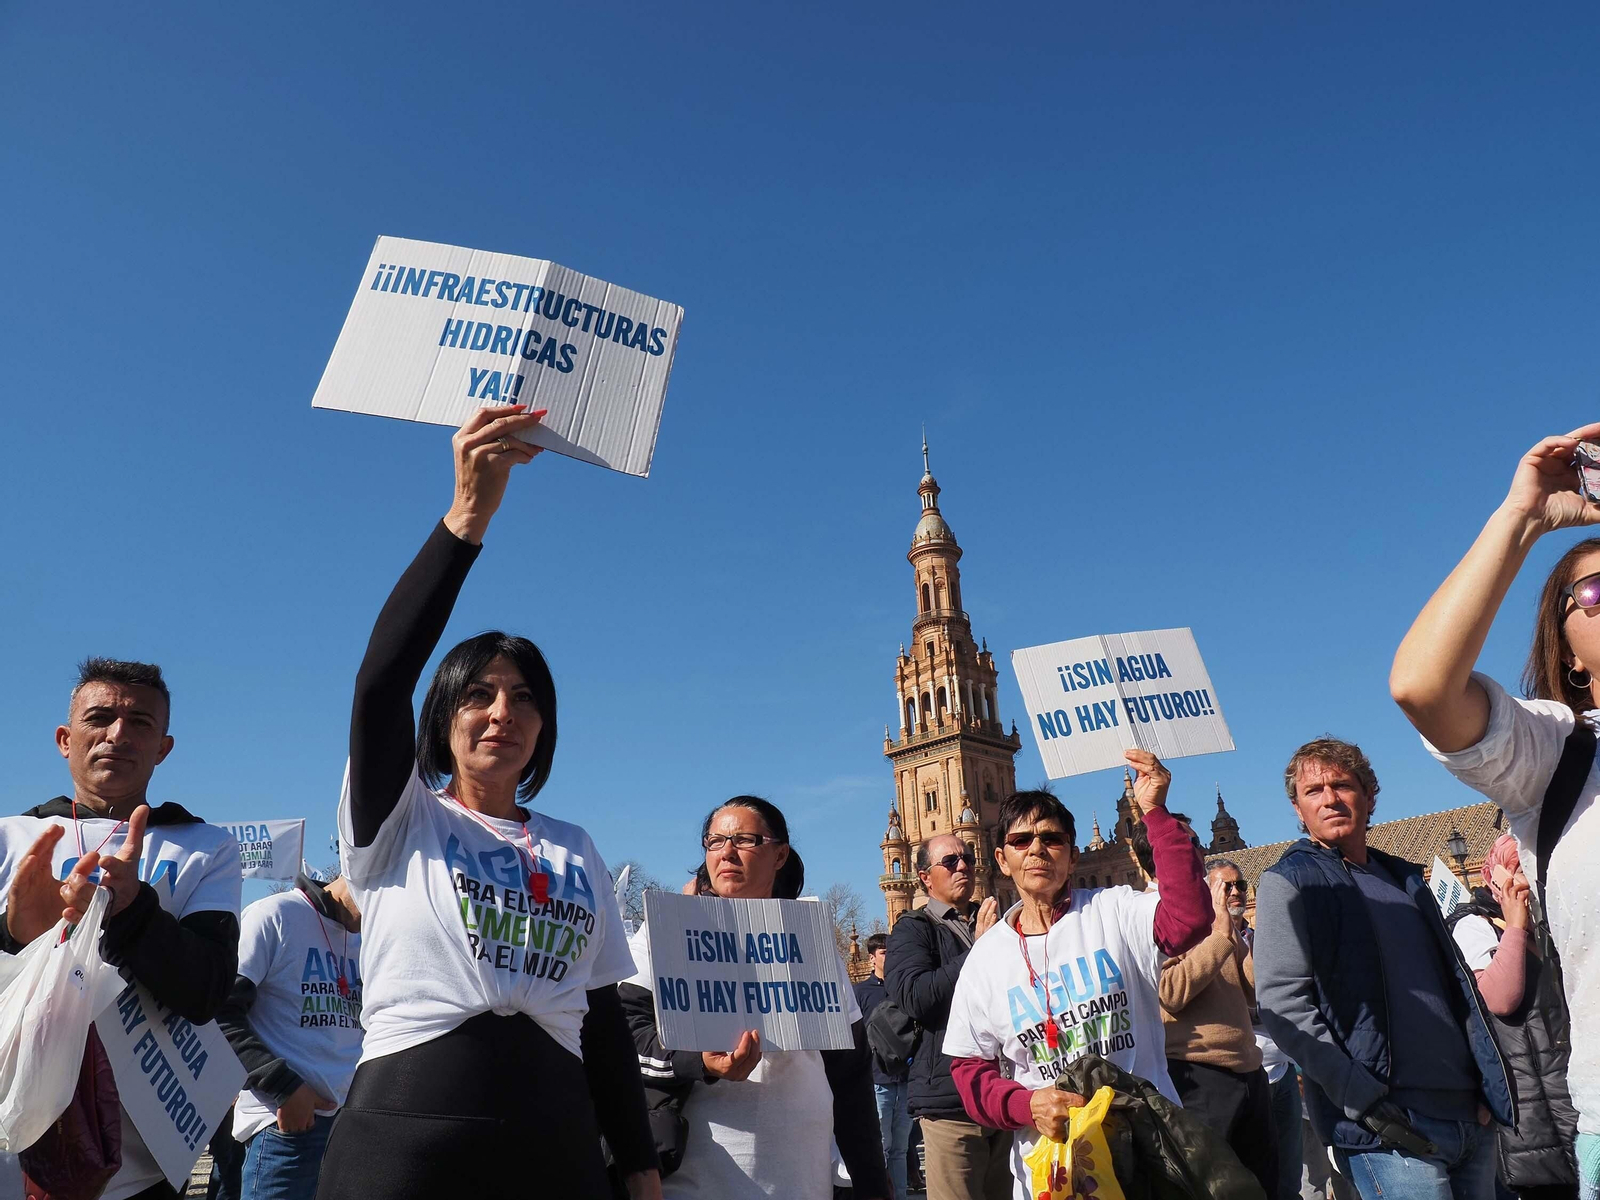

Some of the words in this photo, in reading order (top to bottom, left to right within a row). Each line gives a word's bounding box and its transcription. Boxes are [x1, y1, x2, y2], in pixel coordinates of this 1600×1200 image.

[370, 263, 668, 356] ¡¡INFRAESTRUCTURAS
[438, 317, 578, 373] HIDRICAS
[466, 367, 525, 405] YA!!
[1057, 657, 1114, 692] ¡¡SIN
[1115, 652, 1172, 683] AGUA
[1037, 709, 1072, 740] NO
[1075, 699, 1119, 733] HAY
[1122, 689, 1215, 724] FUTURO!!
[450, 872, 496, 905] ARA
[504, 888, 528, 914] EL
[527, 893, 595, 936] CAMPO
[461, 896, 588, 963] LIMENTOS
[686, 929, 738, 963] ¡¡SIN
[745, 933, 803, 964] AGUA
[495, 944, 518, 974] EL
[301, 982, 335, 995] PARA
[658, 977, 691, 1012] NO
[696, 980, 737, 1013] HAY
[743, 981, 841, 1014] FUTURO!!
[1007, 948, 1125, 1033] AGUA
[1060, 1010, 1079, 1028] EL
[1078, 991, 1128, 1020] CAMPO
[300, 1014, 336, 1028] PARA
[339, 1015, 350, 1028] EL
[162, 1014, 209, 1081] AGUA
[133, 1028, 208, 1152] FUTURO!!
